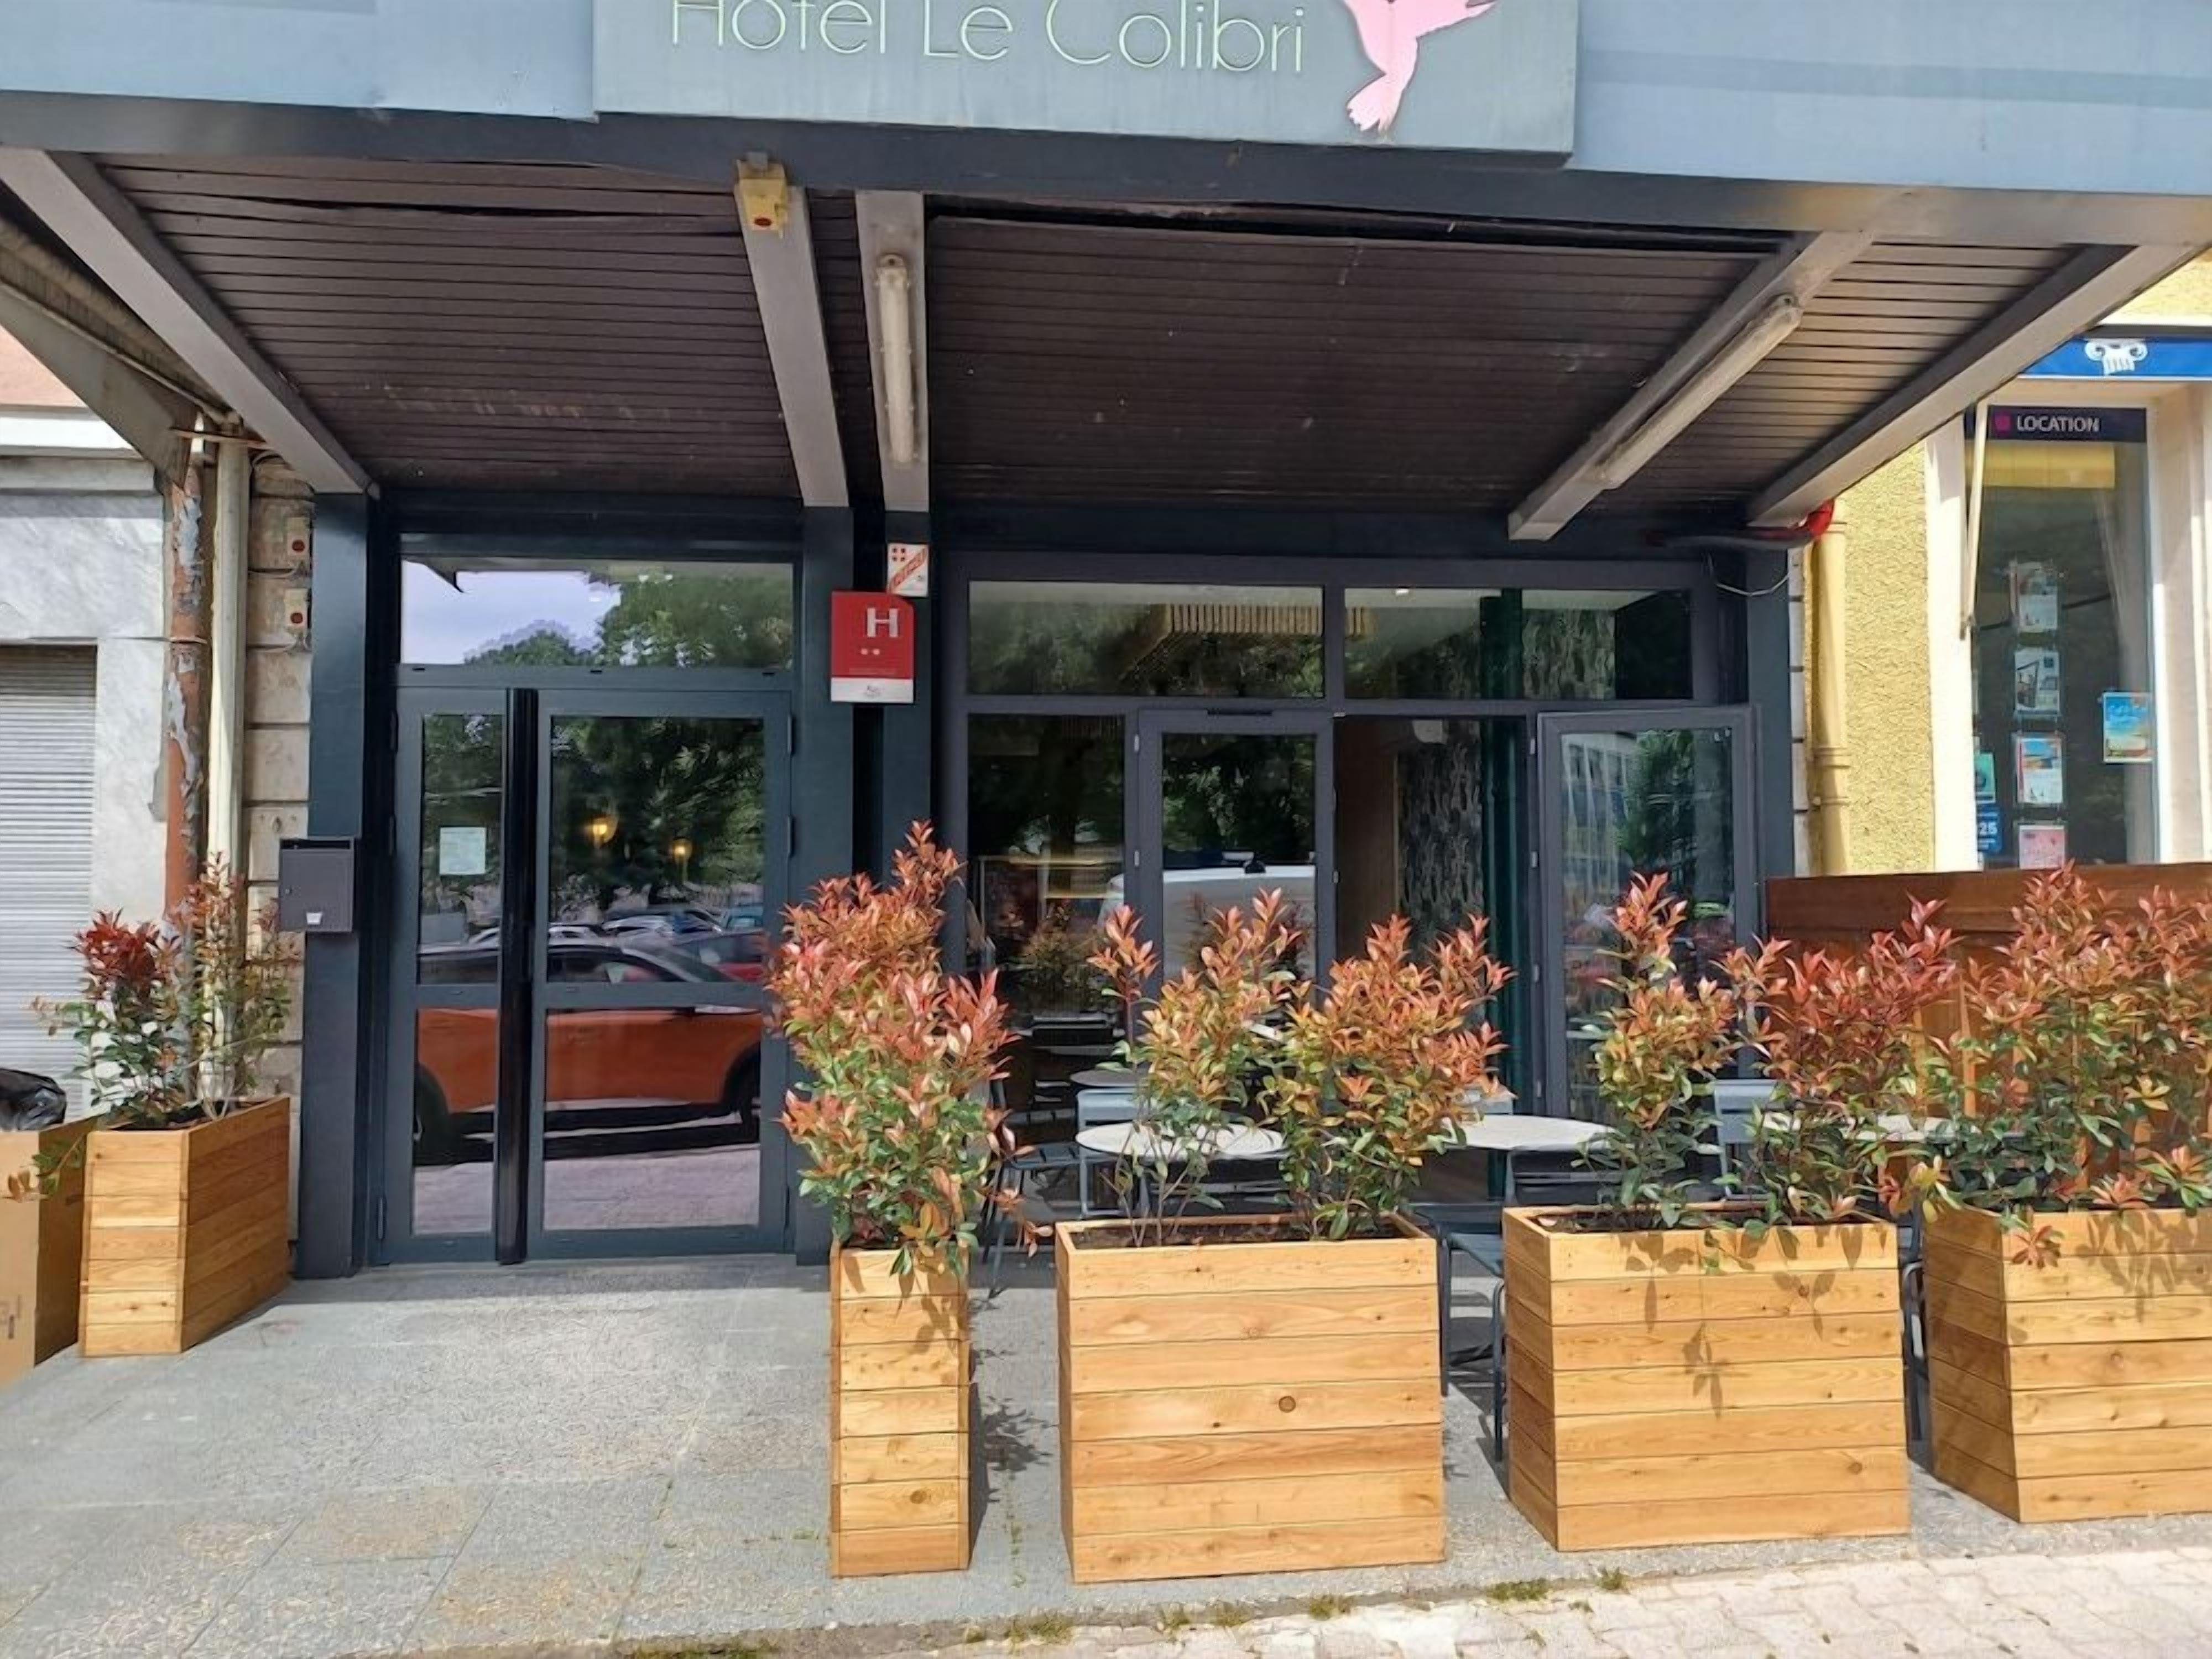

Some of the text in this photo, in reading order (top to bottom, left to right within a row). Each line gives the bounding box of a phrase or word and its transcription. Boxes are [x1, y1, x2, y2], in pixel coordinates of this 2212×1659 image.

[924, 0, 1013, 60] Le
[1046, 0, 1304, 71] Colibri
[2017, 415, 2100, 432] LOCATION
[866, 607, 899, 638] H
